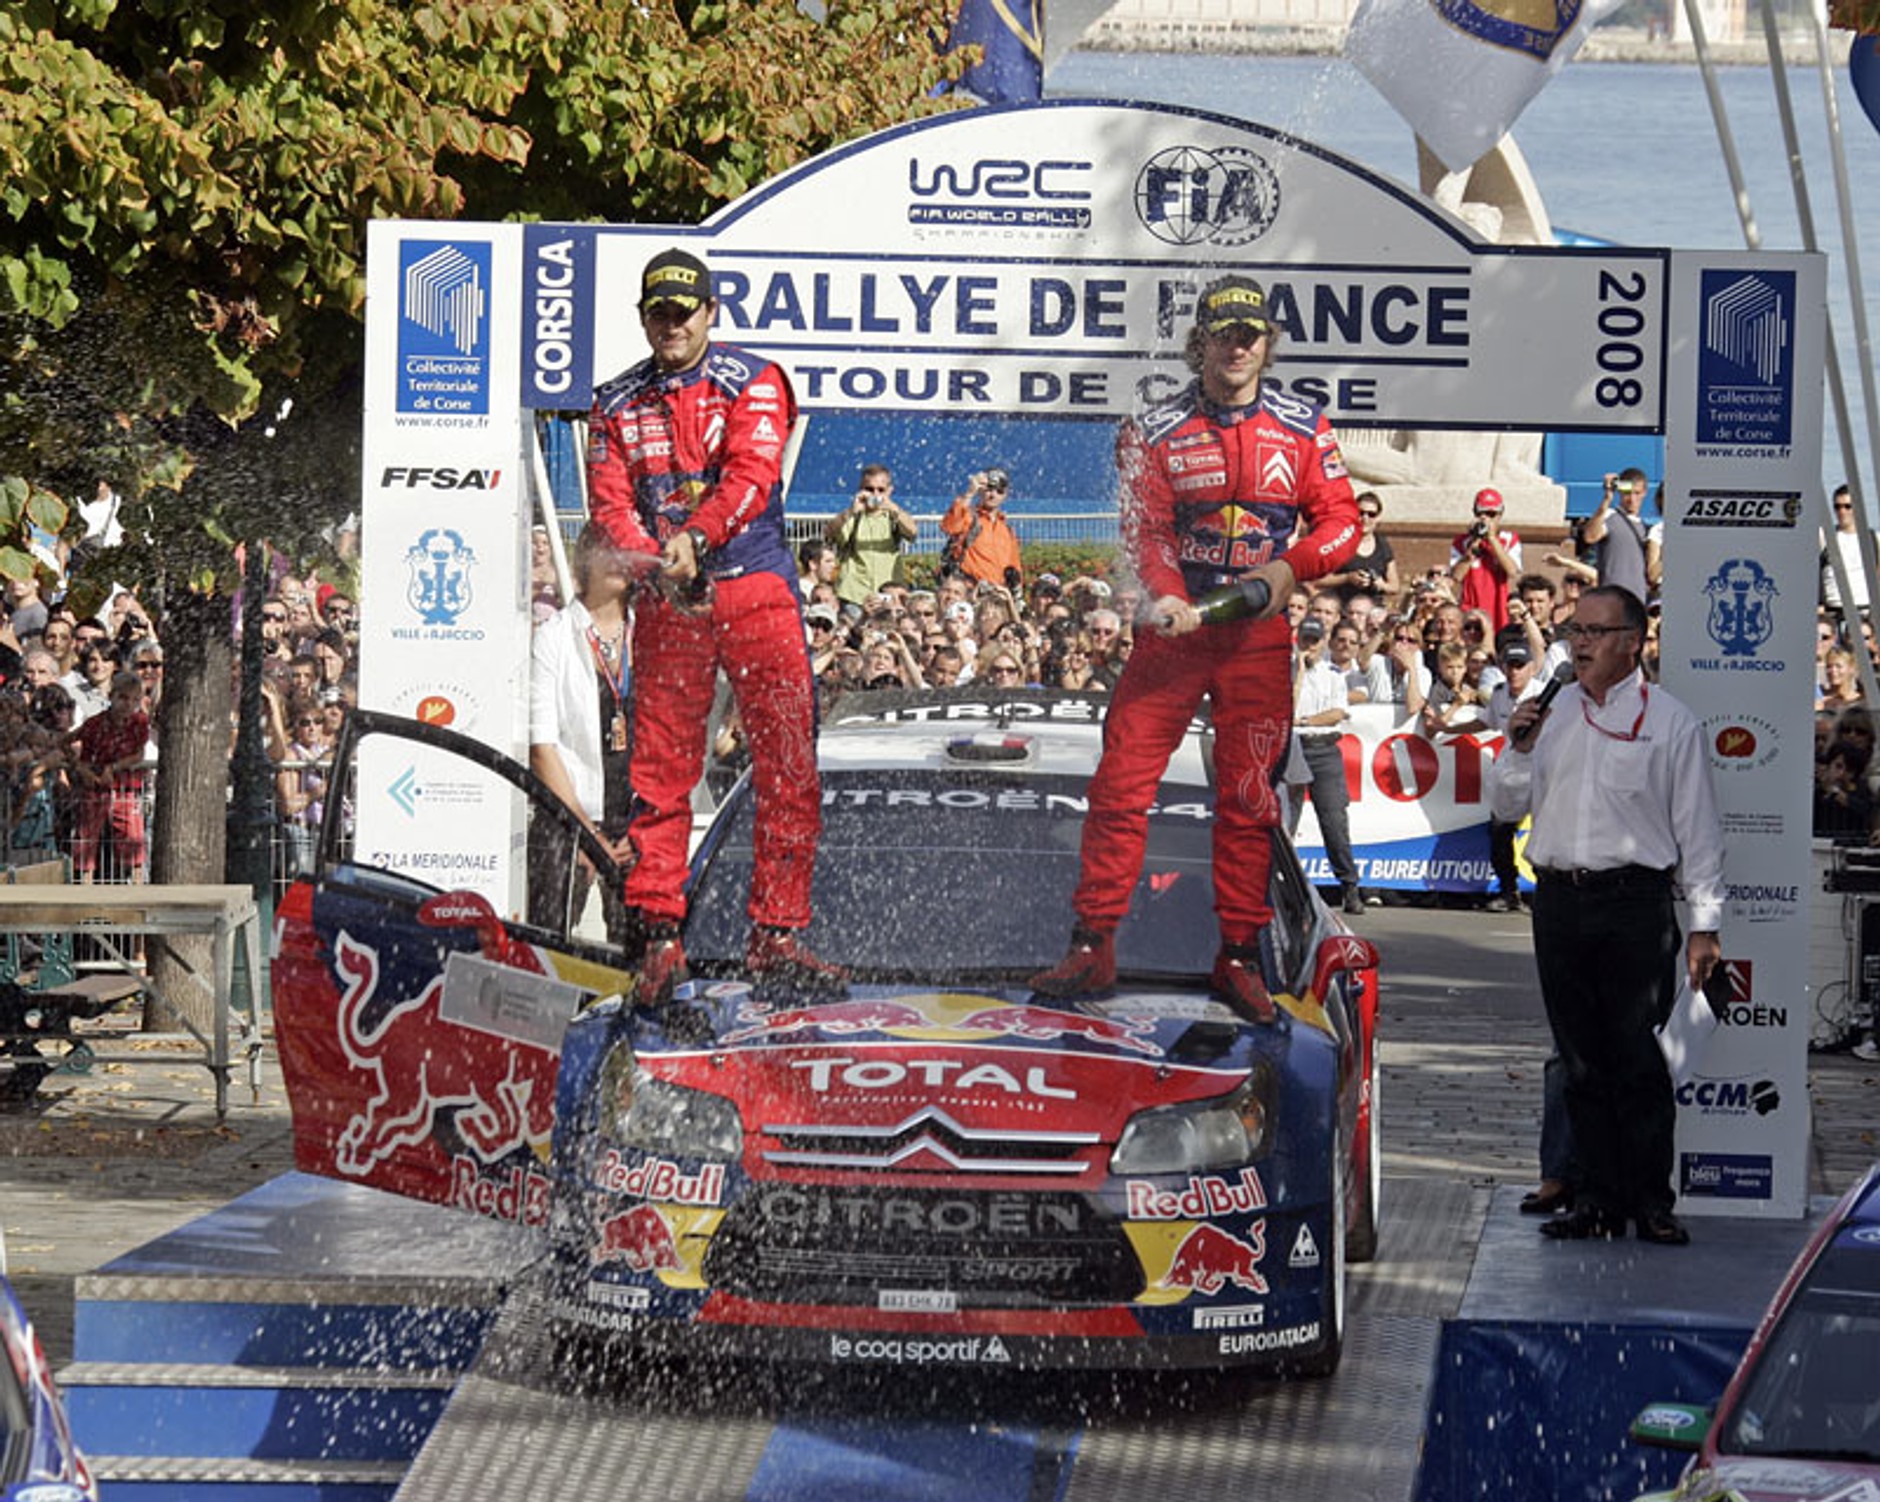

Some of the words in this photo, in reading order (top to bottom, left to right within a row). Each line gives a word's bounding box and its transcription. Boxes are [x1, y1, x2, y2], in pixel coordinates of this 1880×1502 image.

[909, 157, 1093, 199] WRC
[947, 208, 1017, 223] WORLD
[1022, 211, 1090, 228] RALLY
[535, 240, 574, 393] CORSICA
[711, 271, 998, 336] RALLYE
[1029, 277, 1127, 338] DE
[1157, 279, 1470, 347] FANCE
[1596, 270, 1646, 408] 2008
[406, 360, 481, 375] Collectivité
[408, 379, 479, 393] Territoriale
[796, 367, 990, 402] TOUR
[1019, 371, 1108, 405] DE
[1136, 374, 1377, 411] CSE
[1708, 390, 1782, 405] Collectivité
[413, 396, 431, 410] de
[434, 397, 472, 411] Corse
[1710, 408, 1780, 422] Territoriale
[394, 416, 489, 428] www.corse.fr
[1715, 427, 1732, 441] de
[1735, 428, 1773, 440] Corse
[1695, 446, 1791, 459] www.corse.fr
[381, 467, 487, 490] FFSA
[1687, 500, 1773, 518] ASACC
[1179, 532, 1226, 565] Red
[1230, 540, 1274, 566] Bull
[1690, 658, 1720, 670] VILLE
[821, 789, 1089, 812] ITROËN
[392, 853, 409, 868] LA
[411, 853, 498, 871] MERIDIONALE
[432, 906, 483, 919] TOTAL
[791, 1057, 1077, 1099] TOTAL
[1676, 1082, 1748, 1107] CCM
[451, 1155, 521, 1221] Red
[596, 1148, 656, 1196] Red
[649, 1160, 726, 1205] Bull
[1126, 1176, 1209, 1219] Red
[1204, 1166, 1267, 1217] Bull
[758, 1188, 1081, 1237] CITROËN
[1193, 1304, 1264, 1329] PIRELLI
[831, 1336, 851, 1357] le
[854, 1341, 901, 1363] coq
[905, 1336, 982, 1363] sportif
